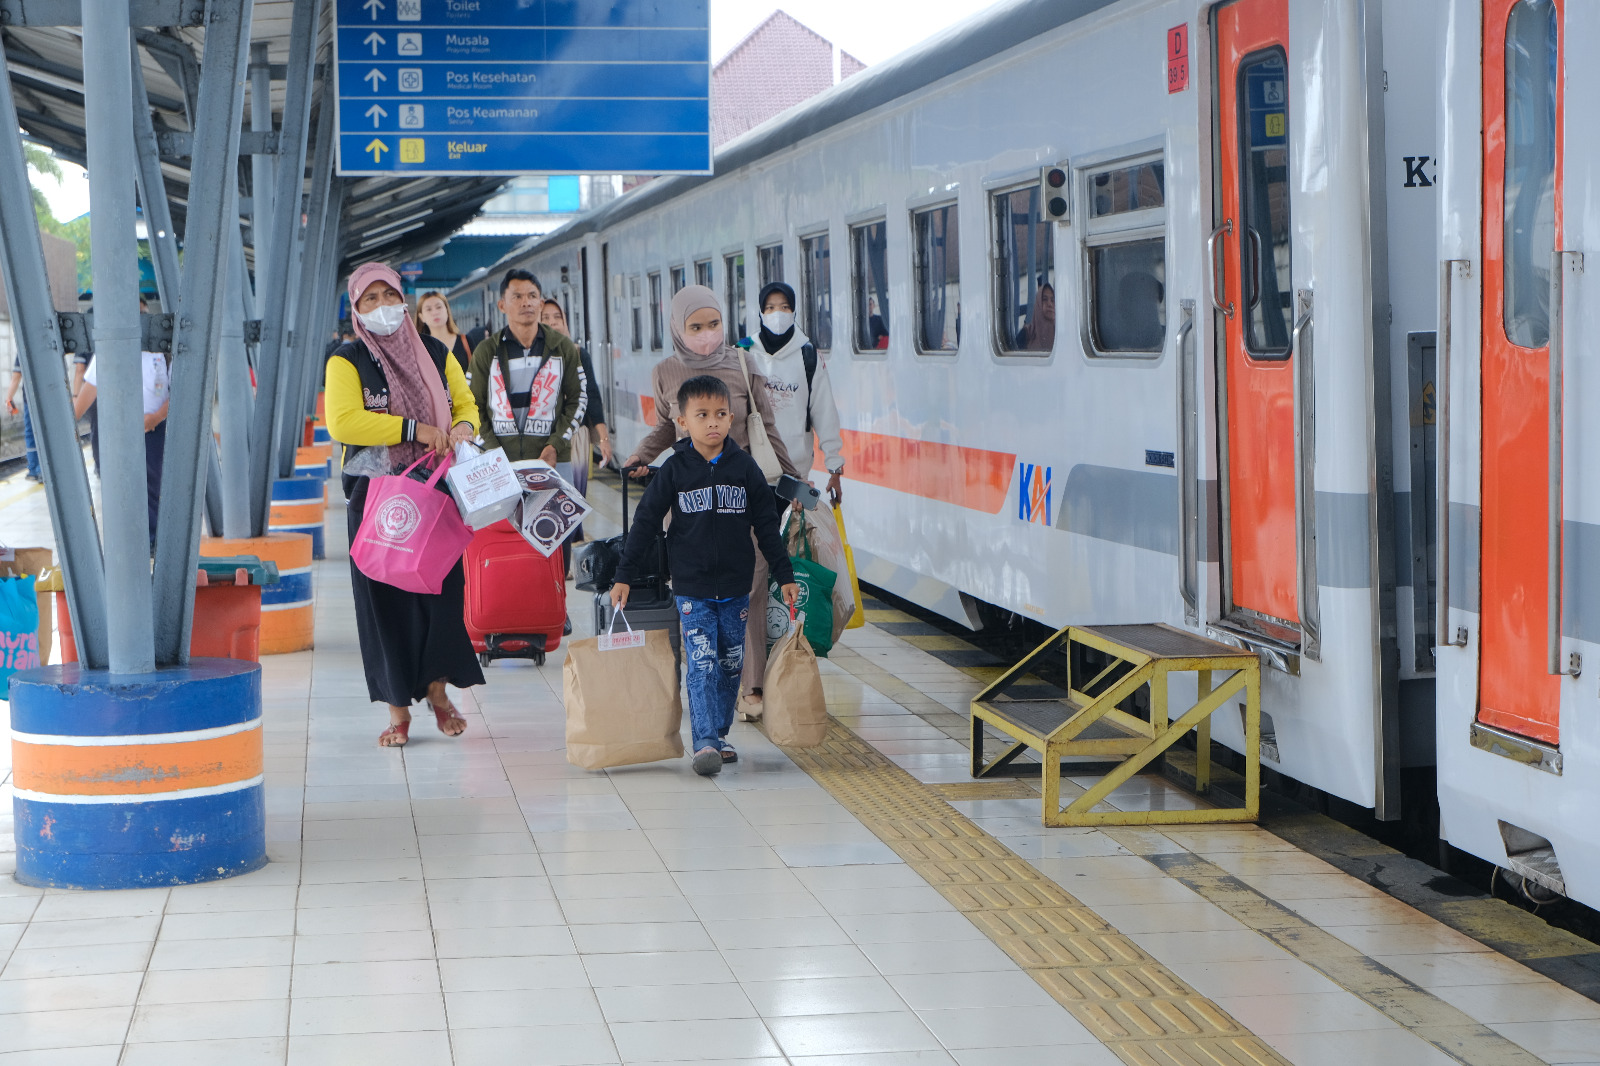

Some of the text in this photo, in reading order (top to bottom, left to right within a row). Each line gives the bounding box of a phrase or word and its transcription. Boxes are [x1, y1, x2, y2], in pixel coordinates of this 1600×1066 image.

[446, 0, 480, 11] Toilet
[446, 34, 490, 46] Musala
[1175, 32, 1182, 55] D
[446, 71, 536, 83] Pos Kesehatan
[447, 107, 538, 118] Pos Keamanan
[447, 141, 488, 153] Keluar
[466, 463, 500, 482] RAYHAN
[678, 484, 747, 513] NEW YORK
[1019, 462, 1052, 527] KAI
